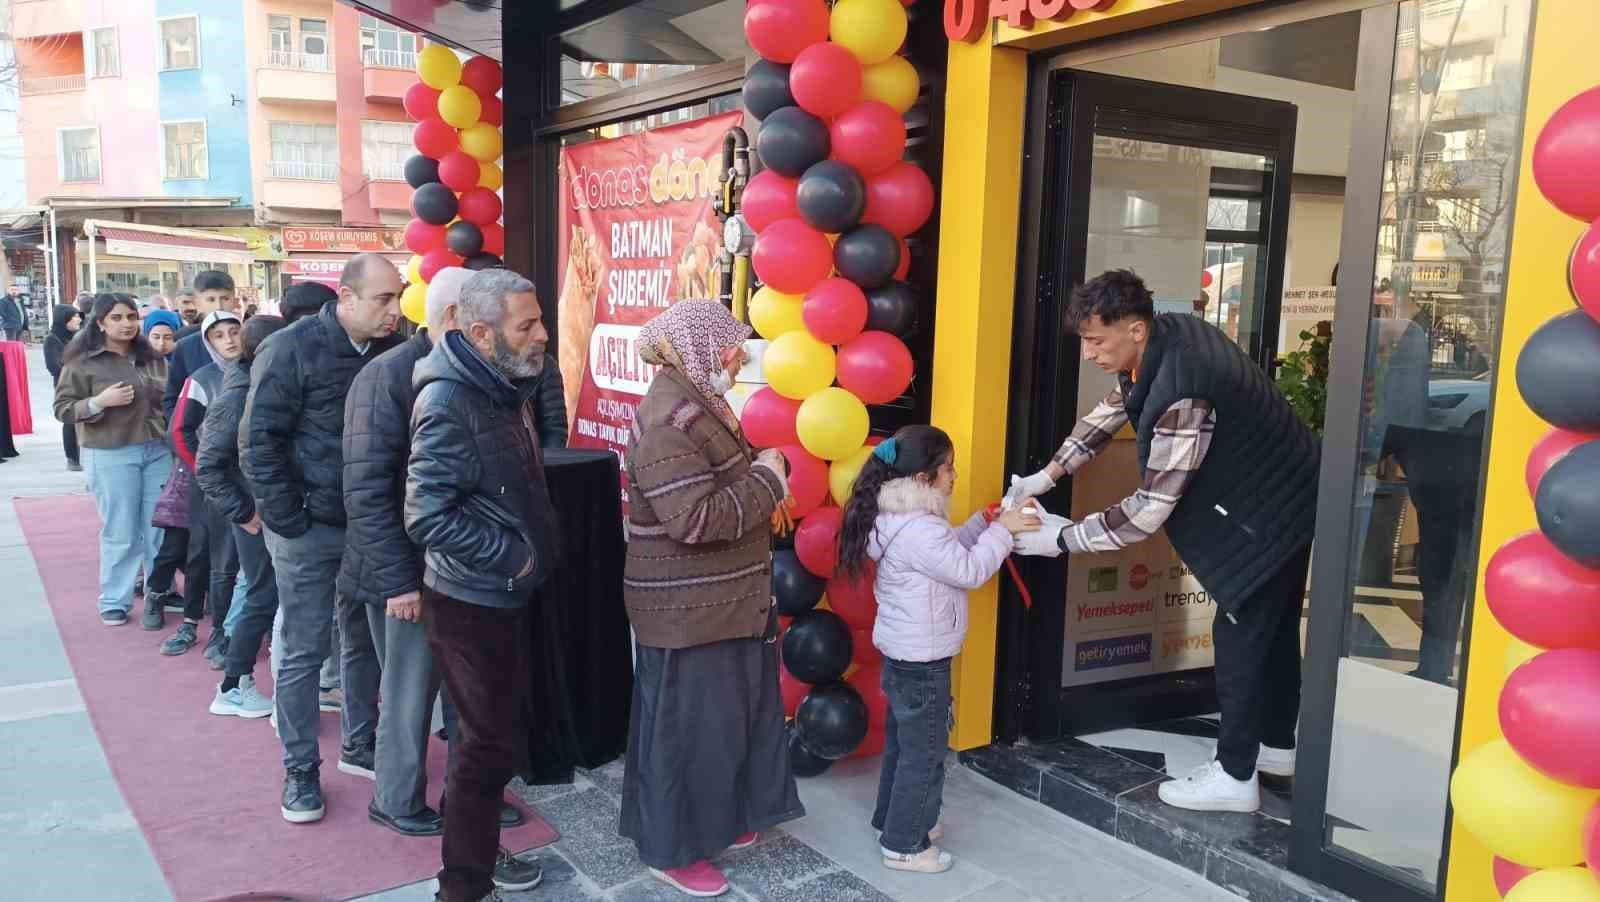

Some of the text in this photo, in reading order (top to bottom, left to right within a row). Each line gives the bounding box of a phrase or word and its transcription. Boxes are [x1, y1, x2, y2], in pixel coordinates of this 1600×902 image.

[569, 164, 649, 209] donas
[610, 218, 673, 258] BATMAN
[607, 260, 673, 315] ŞUBEMİZ
[577, 418, 598, 438] DONAS
[1076, 599, 1154, 622] Yemeksepeti
[1078, 640, 1149, 665] getiryemek
